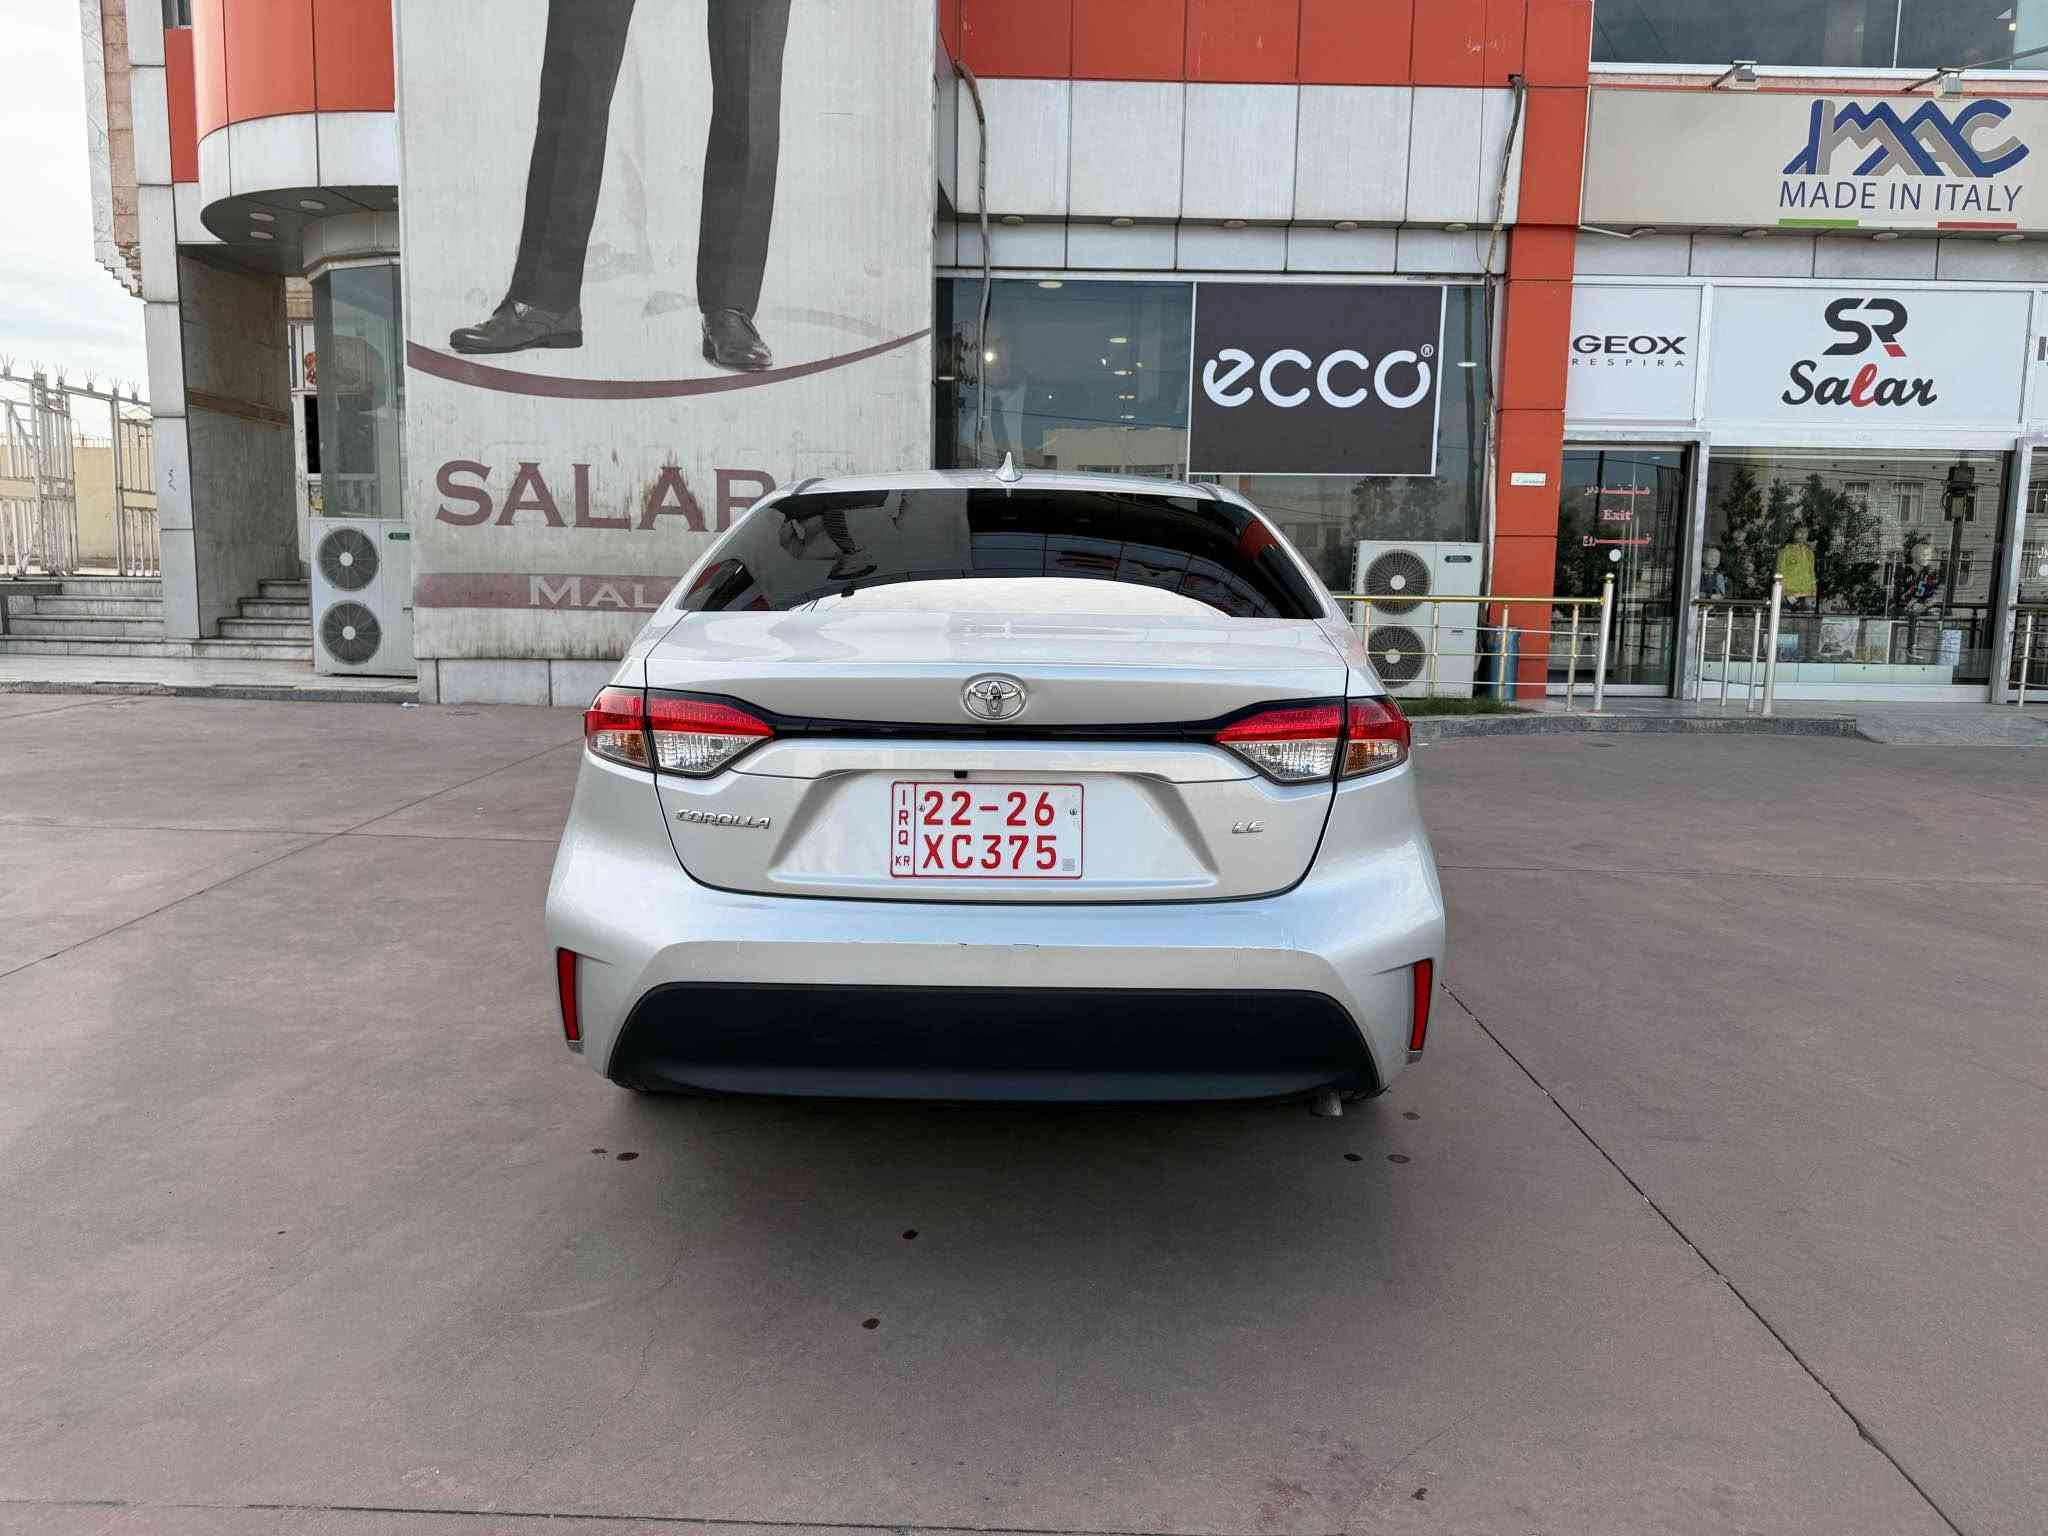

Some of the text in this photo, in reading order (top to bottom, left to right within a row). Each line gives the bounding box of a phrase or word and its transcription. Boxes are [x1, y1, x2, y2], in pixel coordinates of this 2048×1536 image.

[1779, 181, 2024, 212] MADE IN ITALY
[1822, 298, 1908, 357] SR
[1572, 335, 1687, 354] GEOX
[1572, 358, 1686, 367] RESPIRA
[1782, 360, 1938, 408] Salar
[1603, 509, 1633, 521] Exit
[677, 808, 771, 829] COROLLA
[923, 790, 1056, 826] 22-26
[922, 834, 1057, 870] XC375
